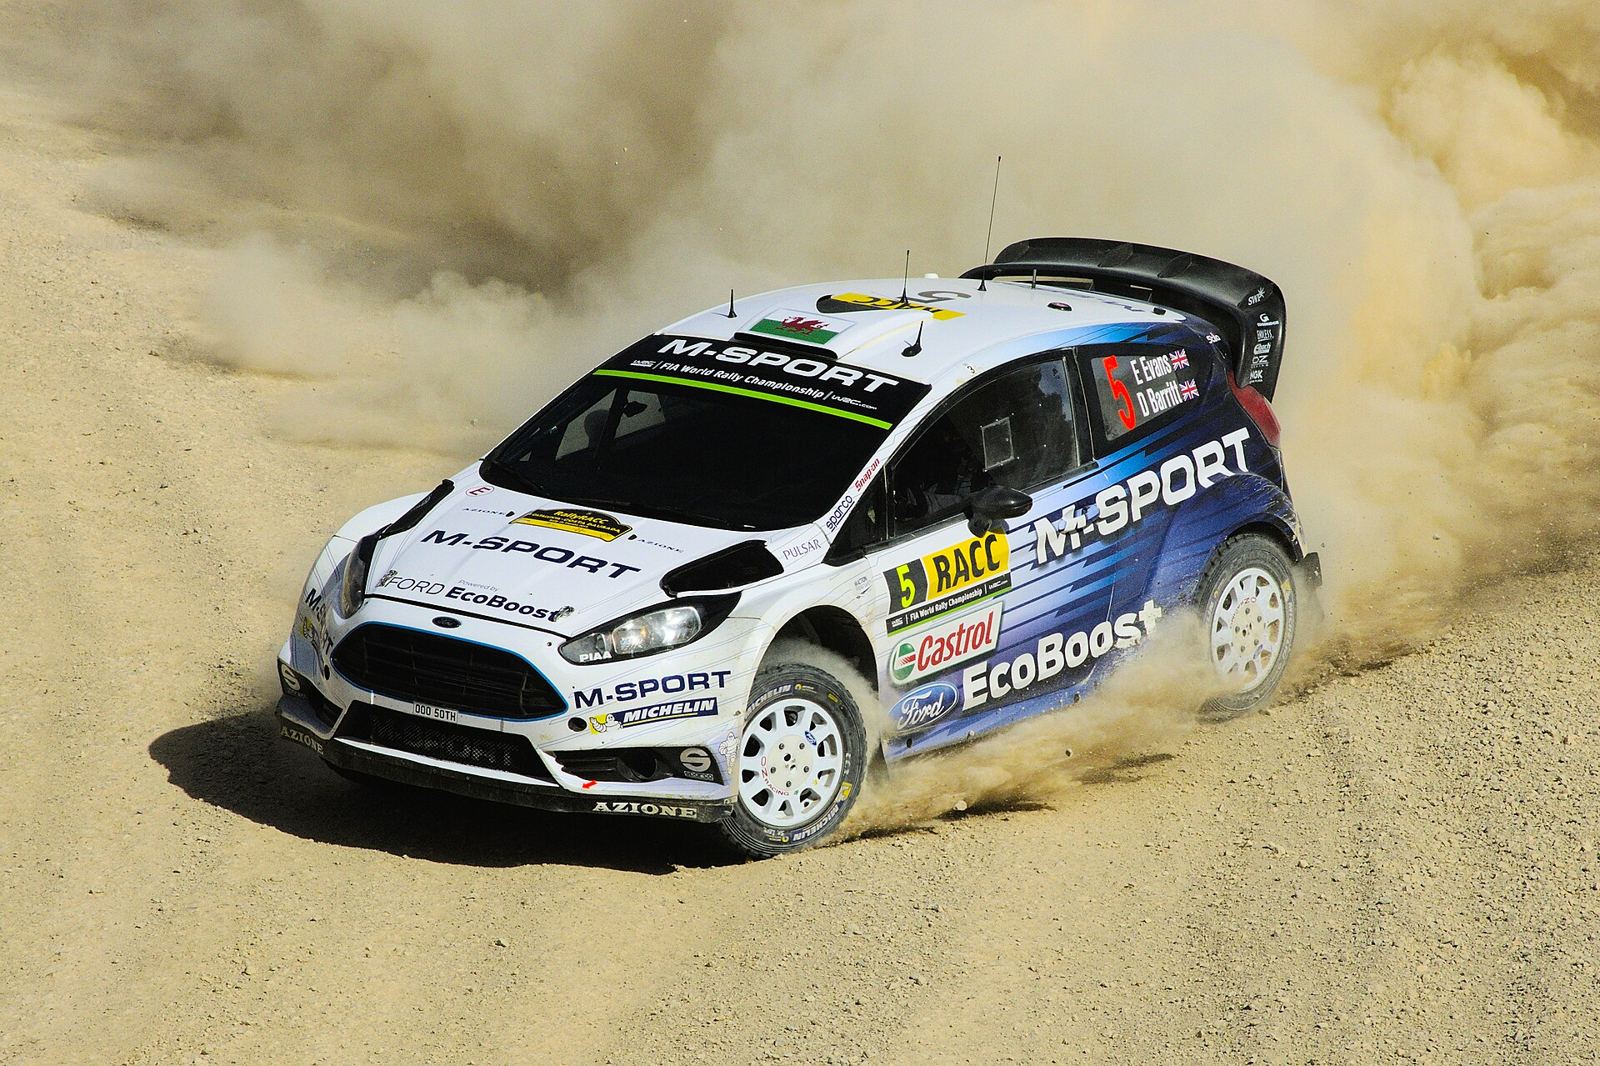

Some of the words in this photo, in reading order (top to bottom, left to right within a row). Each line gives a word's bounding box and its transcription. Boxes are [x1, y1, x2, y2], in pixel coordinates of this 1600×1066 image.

[657, 339, 899, 393] M-SPORT
[659, 361, 681, 371] FIA
[680, 364, 714, 377] World
[713, 369, 745, 384] Rally
[744, 375, 825, 399] Championship
[1130, 359, 1143, 385] E
[1143, 354, 1172, 380] Evans
[1103, 354, 1136, 430] 5
[1136, 392, 1149, 417] D
[1148, 380, 1183, 414] Barritt
[825, 495, 855, 532] sparco
[1034, 426, 1250, 565] M-SPORT
[553, 510, 610, 526] RallyRACC
[421, 530, 641, 579] M-SPORT
[782, 539, 821, 560] PULSAR
[384, 576, 446, 595] FORD
[896, 564, 916, 608] 5
[932, 534, 1001, 592] RACC
[445, 586, 561, 622] EcoBoost
[909, 610, 919, 622] FIA
[919, 606, 935, 618] World
[935, 600, 948, 613] Rally
[948, 587, 983, 608] Championship
[579, 651, 612, 663] PIAA
[917, 609, 994, 673] Castrol
[962, 600, 1163, 712] EcoBoost
[573, 670, 731, 710] M-SPORT
[622, 699, 715, 723] MICHELIN
[898, 691, 944, 731] Ford
[280, 726, 324, 756] AZIONE
[592, 801, 697, 820] AZIONE
